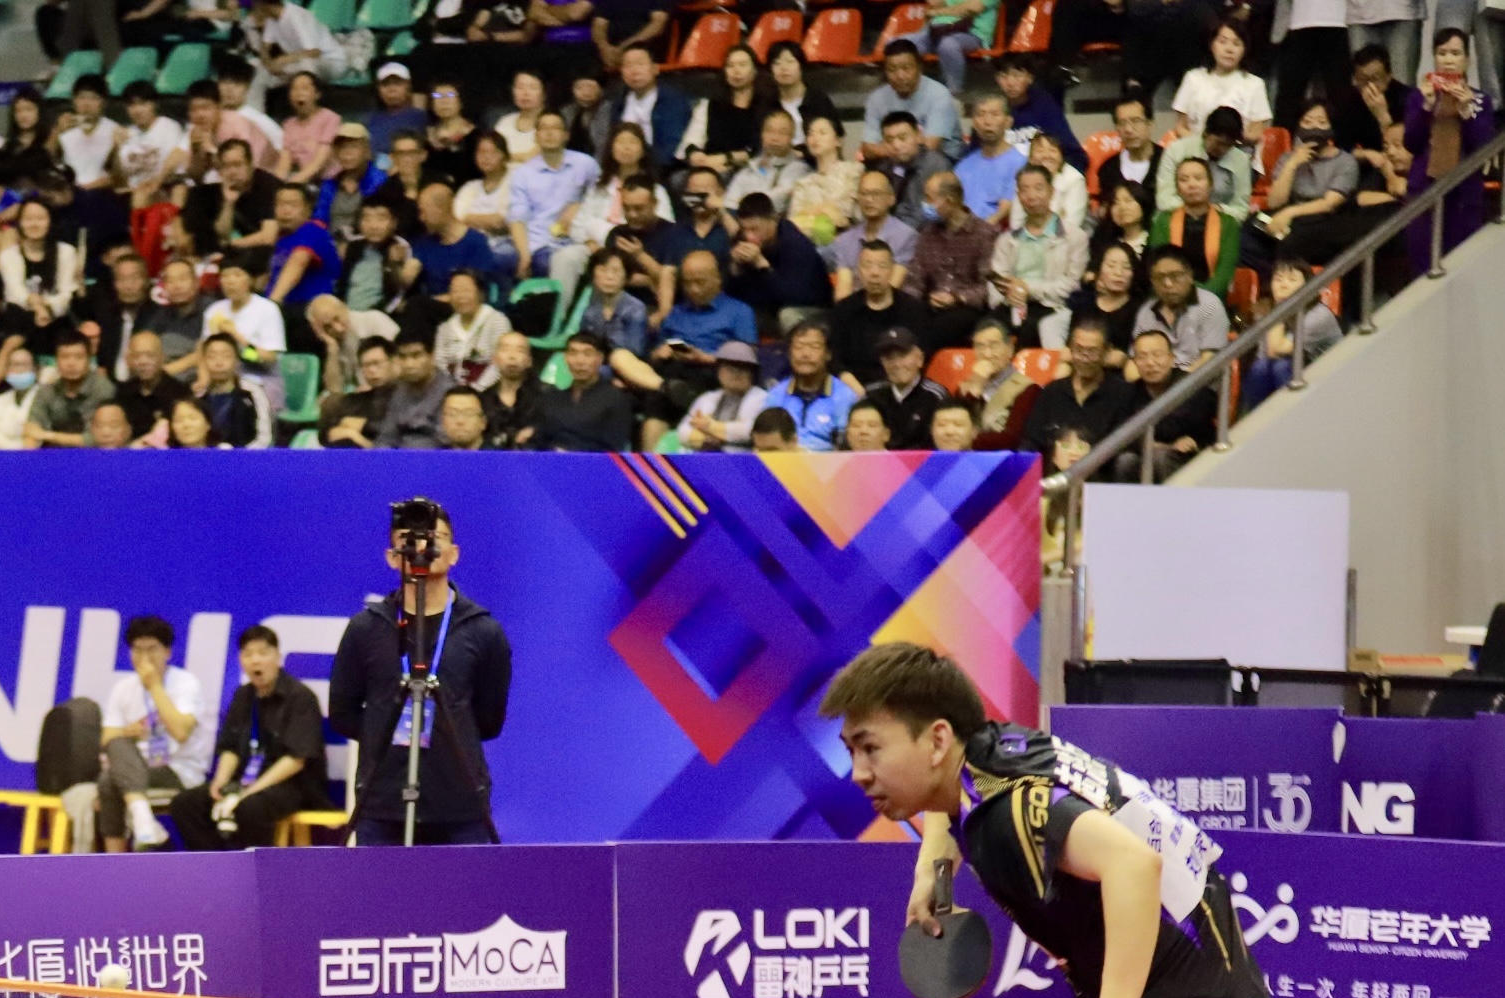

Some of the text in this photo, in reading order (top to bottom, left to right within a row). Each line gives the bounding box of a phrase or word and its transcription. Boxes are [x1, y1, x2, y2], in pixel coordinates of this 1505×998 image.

[1342, 781, 1416, 836] NG
[753, 907, 870, 950] LOKI
[1309, 905, 1492, 949] 华夏老年大学
[320, 933, 443, 996] 西府
